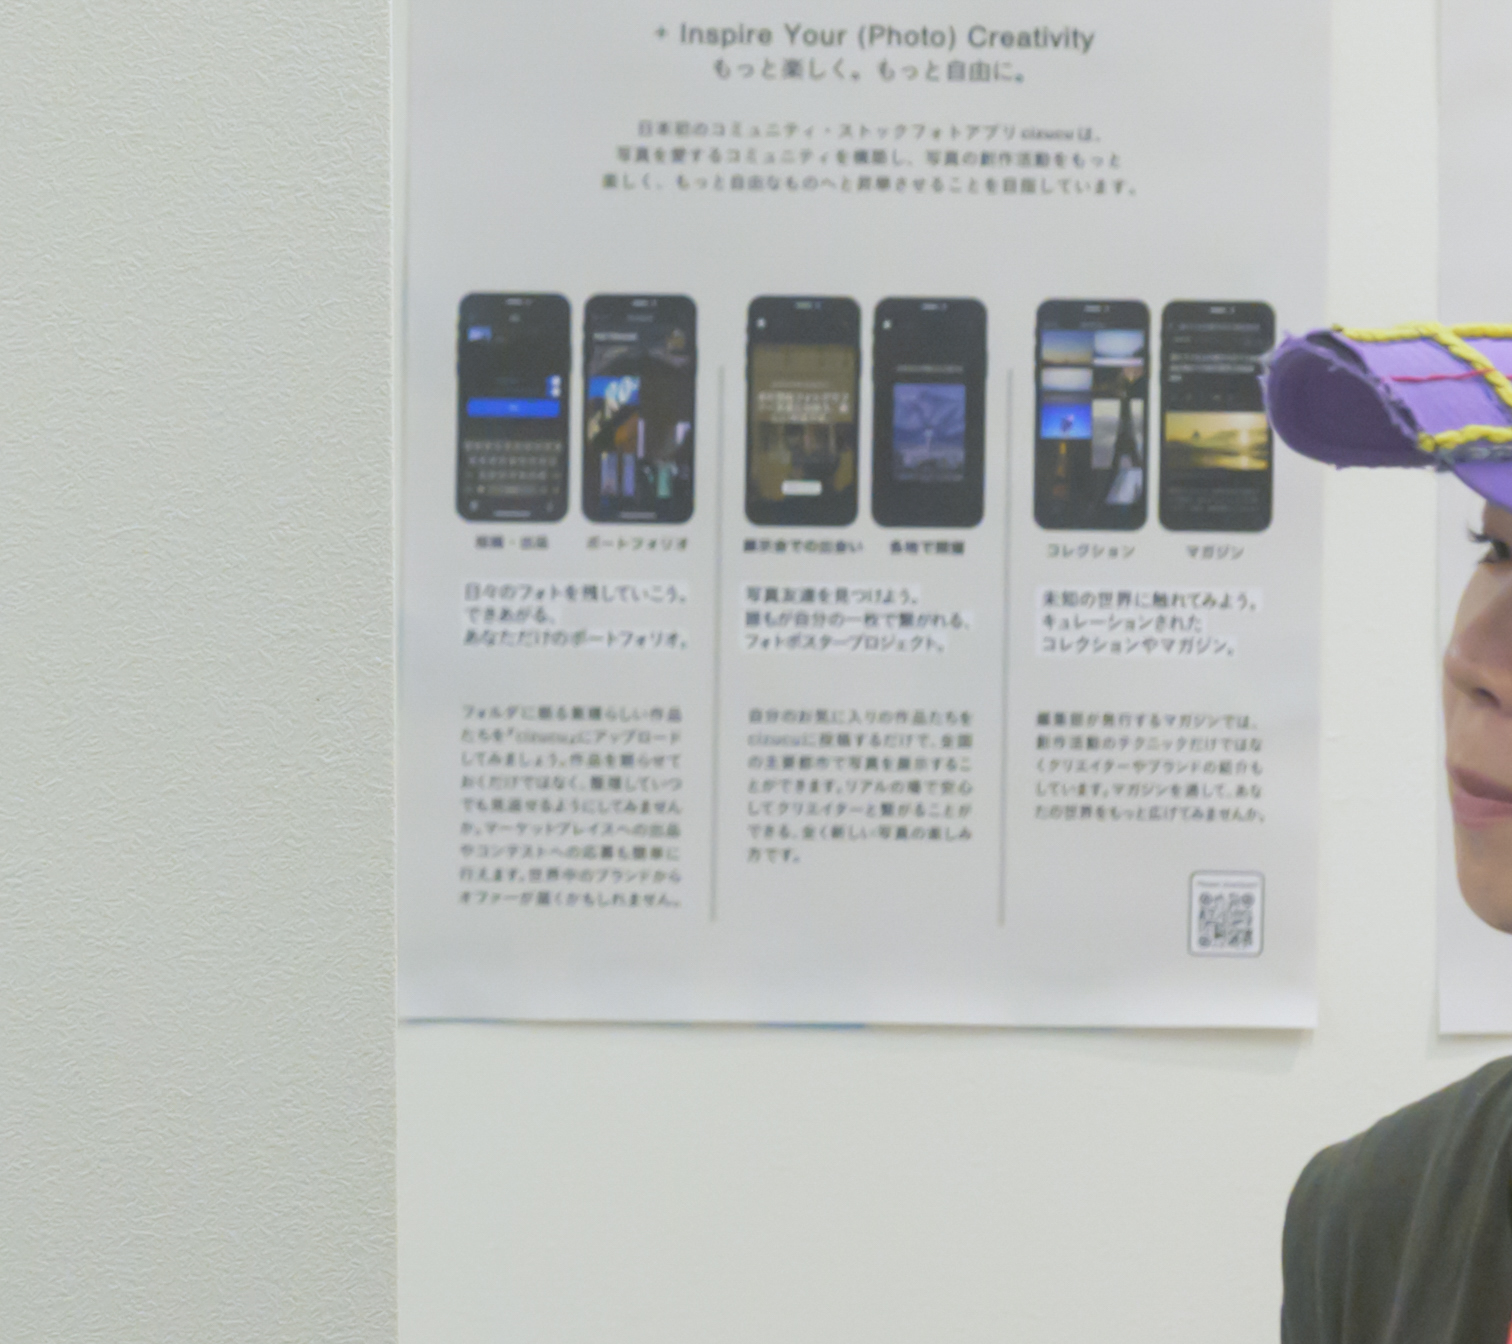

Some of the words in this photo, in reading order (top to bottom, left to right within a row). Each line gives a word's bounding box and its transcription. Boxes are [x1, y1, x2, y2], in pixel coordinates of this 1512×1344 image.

[679, 21, 774, 50] Inspire
[783, 22, 848, 48] Your
[856, 23, 958, 52] (Photo)
[966, 23, 1096, 55] Creativity
